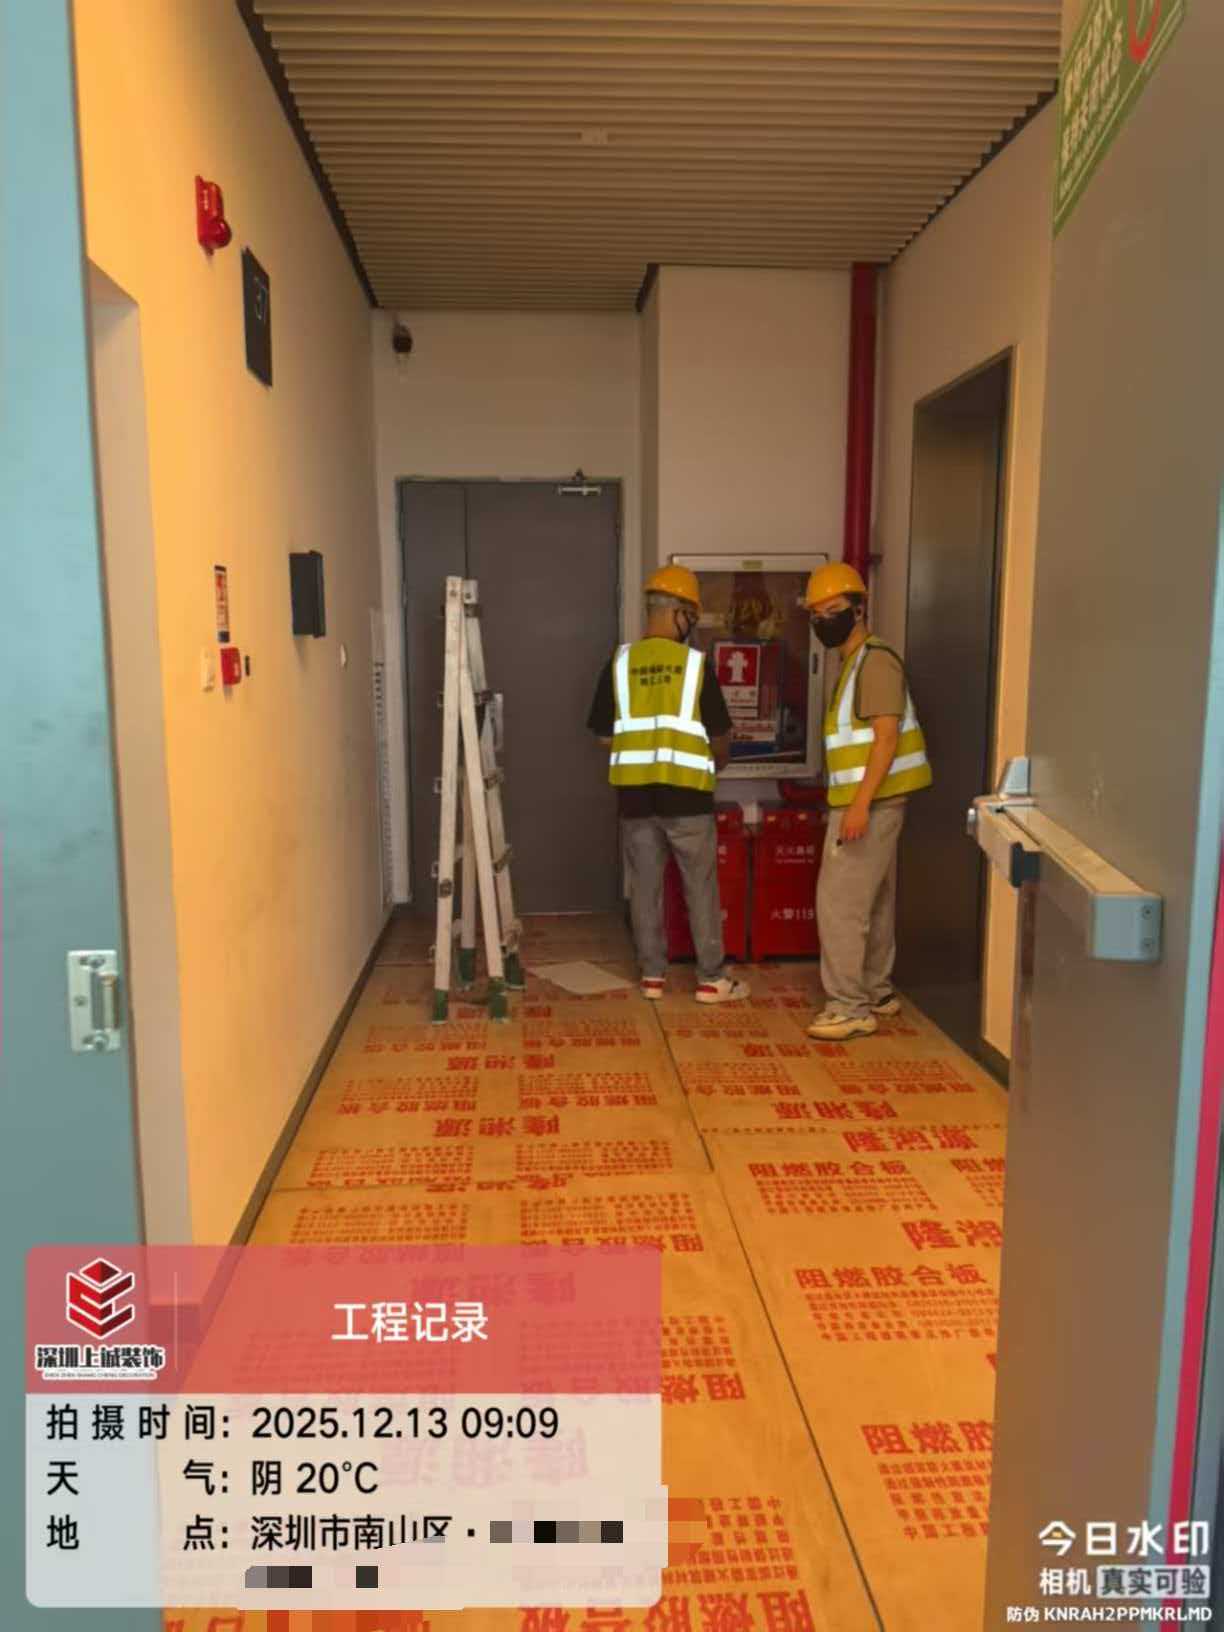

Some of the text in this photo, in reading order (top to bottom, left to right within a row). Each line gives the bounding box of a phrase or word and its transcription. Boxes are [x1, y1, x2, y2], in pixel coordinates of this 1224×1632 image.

[795, 1263, 987, 1290] 阻燃胶合板
